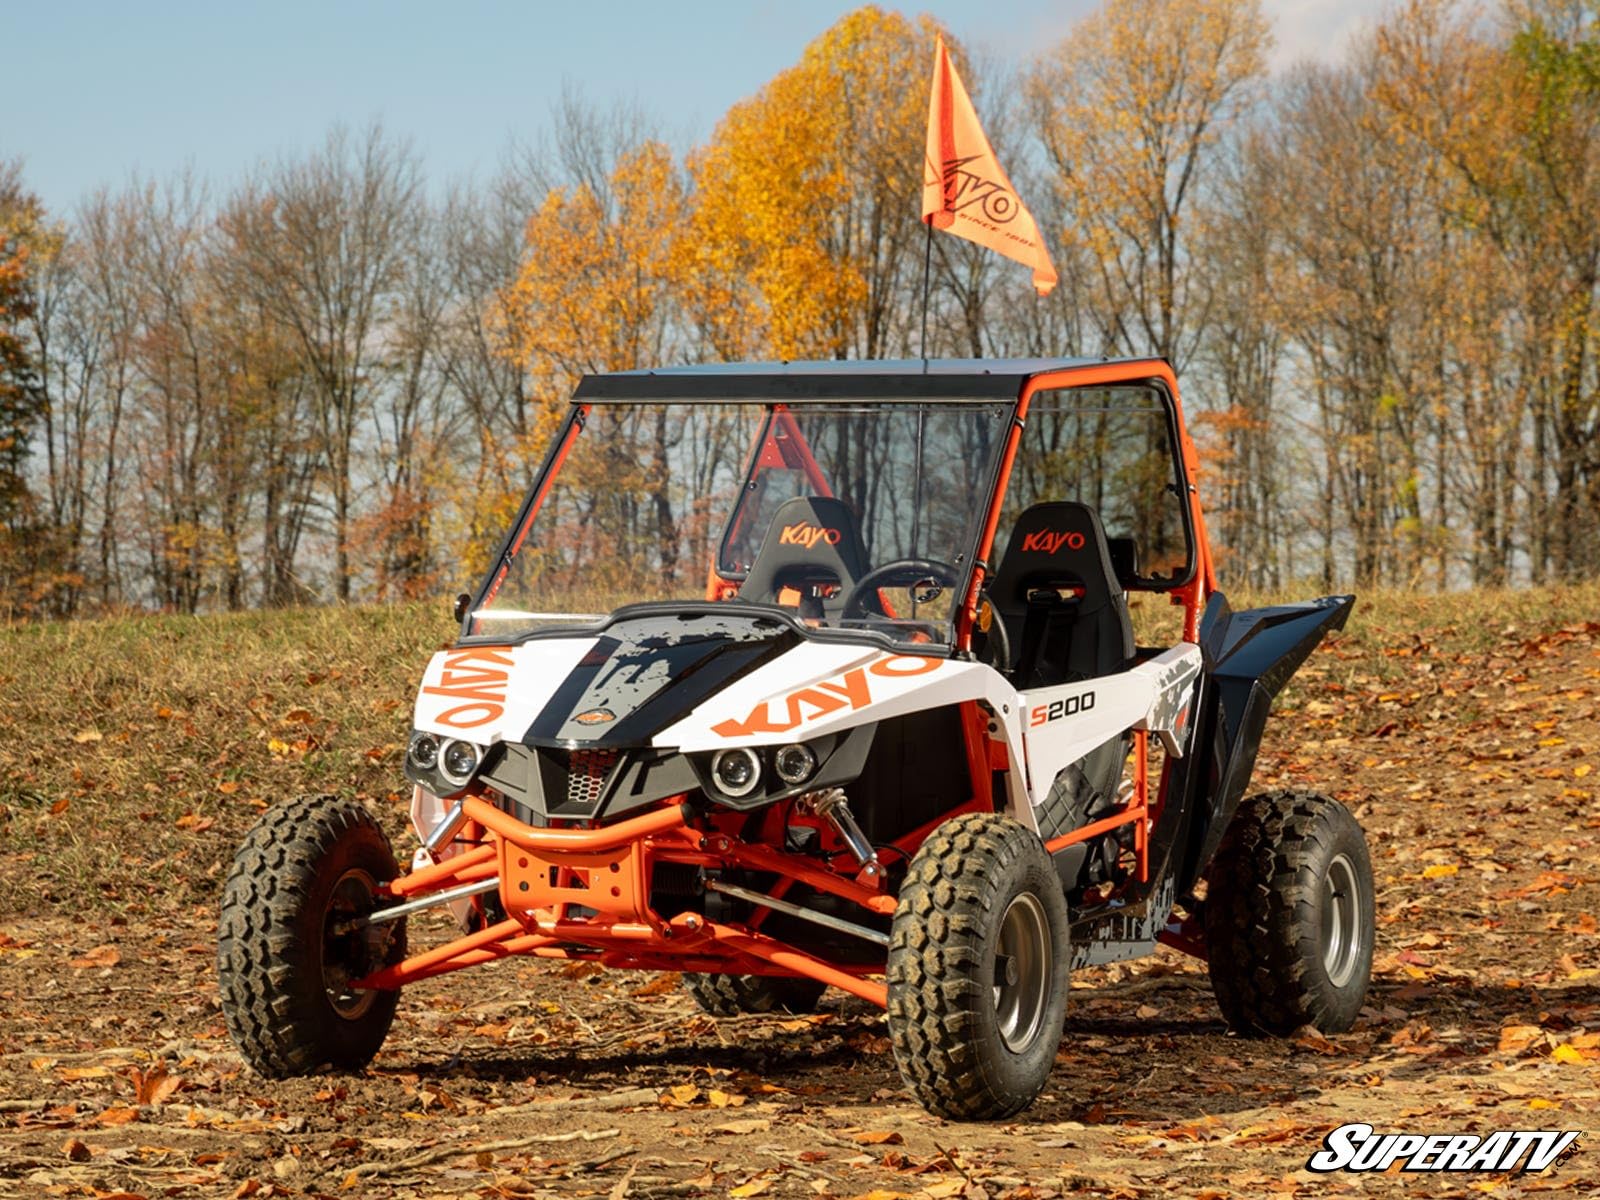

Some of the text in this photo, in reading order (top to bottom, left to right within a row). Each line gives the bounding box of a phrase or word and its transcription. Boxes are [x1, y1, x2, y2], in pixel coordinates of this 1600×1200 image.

[779, 520, 841, 549] KAYO
[1022, 528, 1085, 554] KAYO
[422, 645, 515, 729] KAYO
[710, 654, 944, 738] KAYO
[1030, 691, 1095, 727] S200
